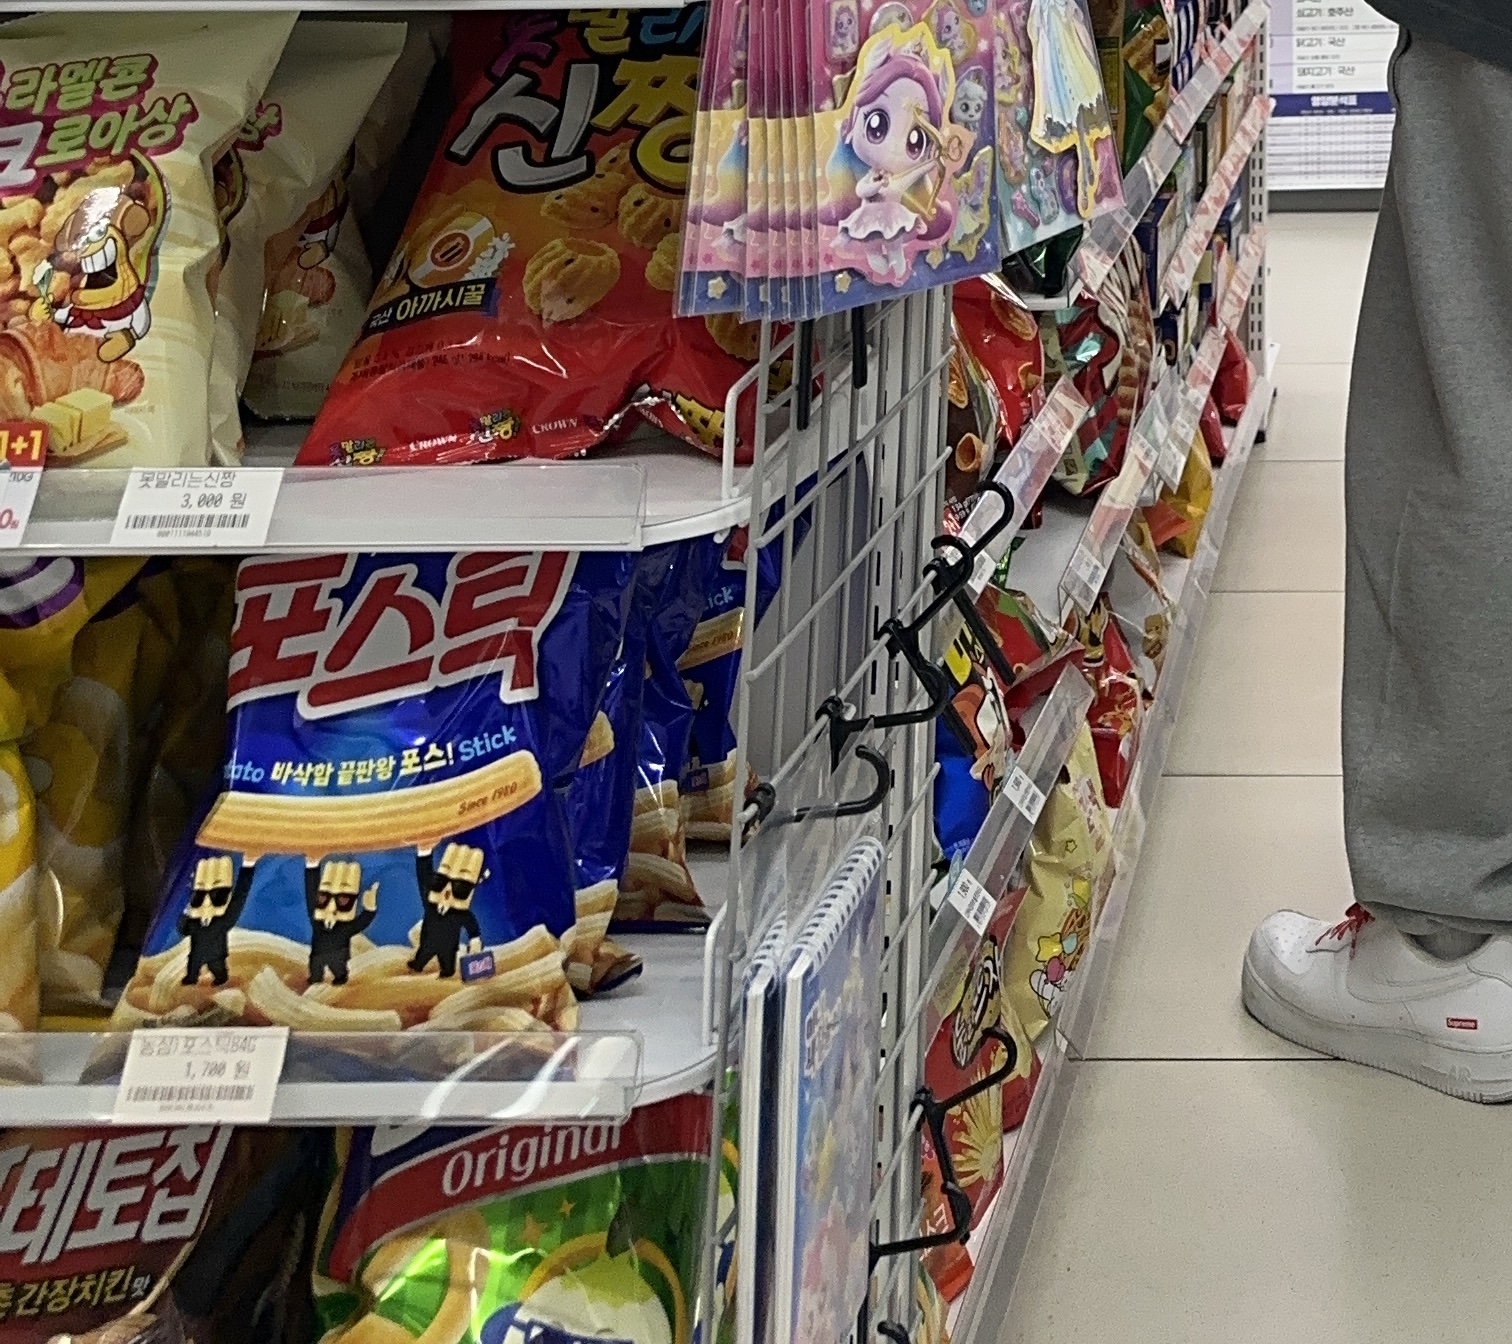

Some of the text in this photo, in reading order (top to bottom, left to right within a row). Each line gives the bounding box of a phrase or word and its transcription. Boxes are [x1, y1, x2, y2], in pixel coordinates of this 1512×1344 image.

[0, 53, 153, 115] 라멜콘
[446, 53, 700, 190] 신짱
[531, 417, 579, 435] CROWN
[137, 470, 237, 488] 못말리는신짱
[181, 492, 223, 509] 3,000
[227, 552, 572, 719] 포스틱
[270, 724, 518, 788] 바삭함 끝판왕 포스! Stick
[440, 1118, 627, 1200] Original
[0, 1124, 231, 1266] 테토칩
